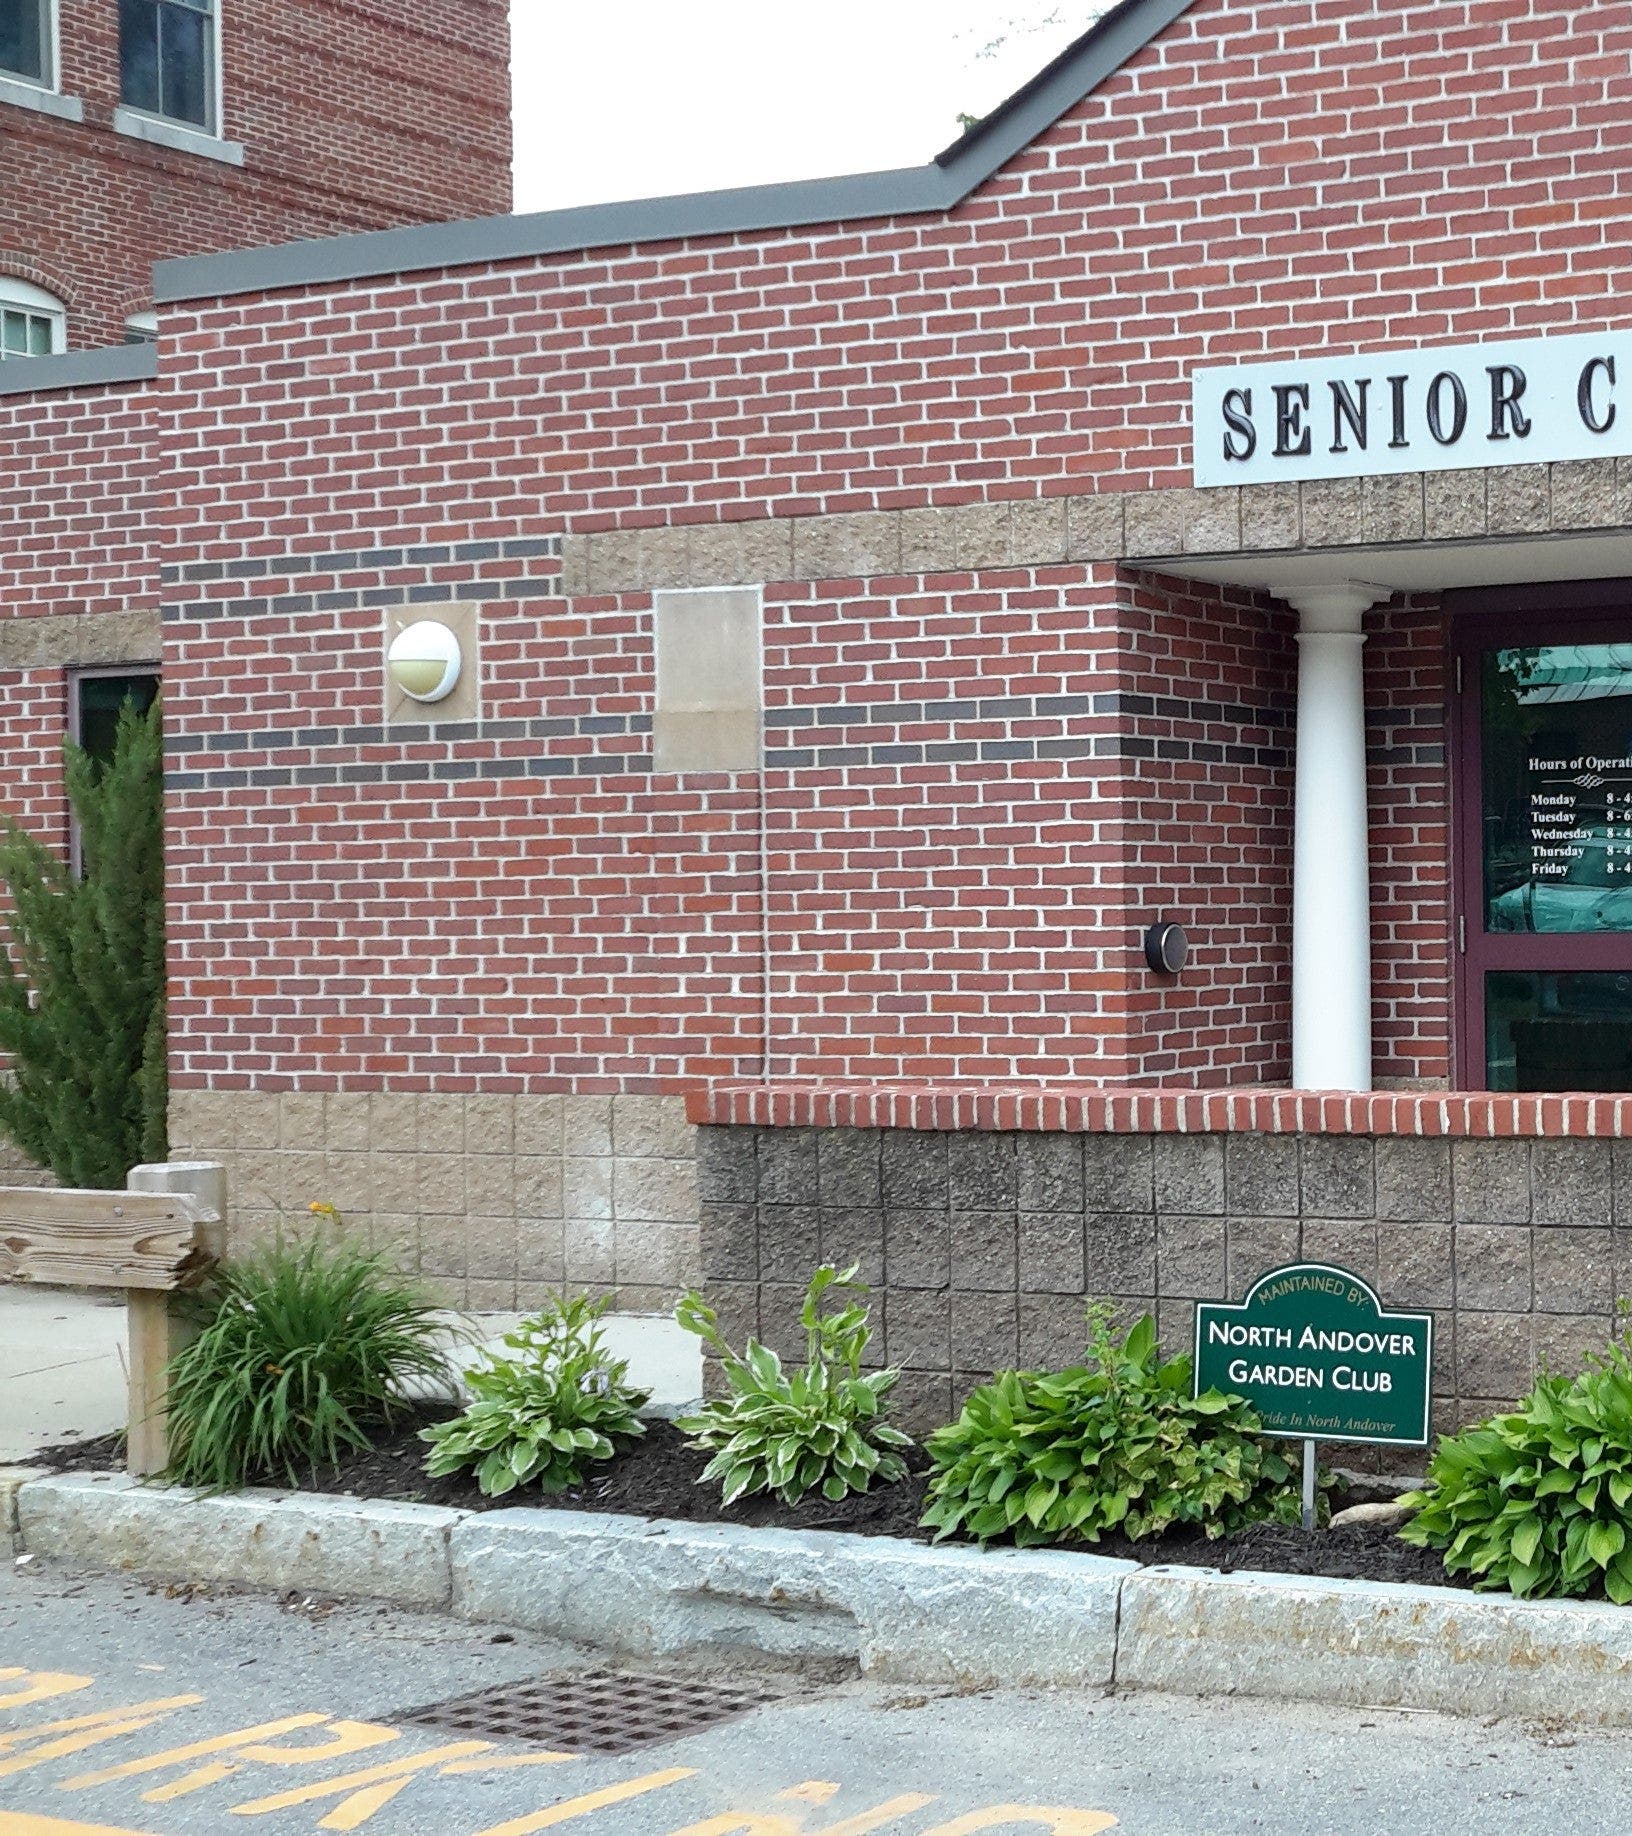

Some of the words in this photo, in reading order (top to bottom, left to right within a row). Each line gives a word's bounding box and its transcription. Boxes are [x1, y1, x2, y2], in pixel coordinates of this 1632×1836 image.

[1221, 363, 1532, 462] SENIOR
[1528, 757, 1567, 771] Hours
[1570, 756, 1584, 769] of
[1530, 793, 1577, 807] Monday
[1606, 792, 1614, 804] 8
[1531, 811, 1576, 824] Tuesday
[1606, 810, 1614, 822] 8
[1531, 828, 1594, 841] Wednesday
[1606, 827, 1614, 839] 8
[1531, 845, 1585, 859] Thursday
[1606, 845, 1614, 856] 8
[1531, 862, 1569, 876] Friday
[1606, 862, 1614, 873] 8
[1257, 1275, 1346, 1306] MAINTAINED
[1208, 1320, 1292, 1349] NORTH
[1297, 1325, 1416, 1356] ANDOVER
[1228, 1359, 1324, 1389] GARDEN
[1331, 1366, 1393, 1393] CLUB
[1289, 1412, 1303, 1426] In
[1306, 1414, 1341, 1429] North
[1343, 1416, 1396, 1433] Andover
